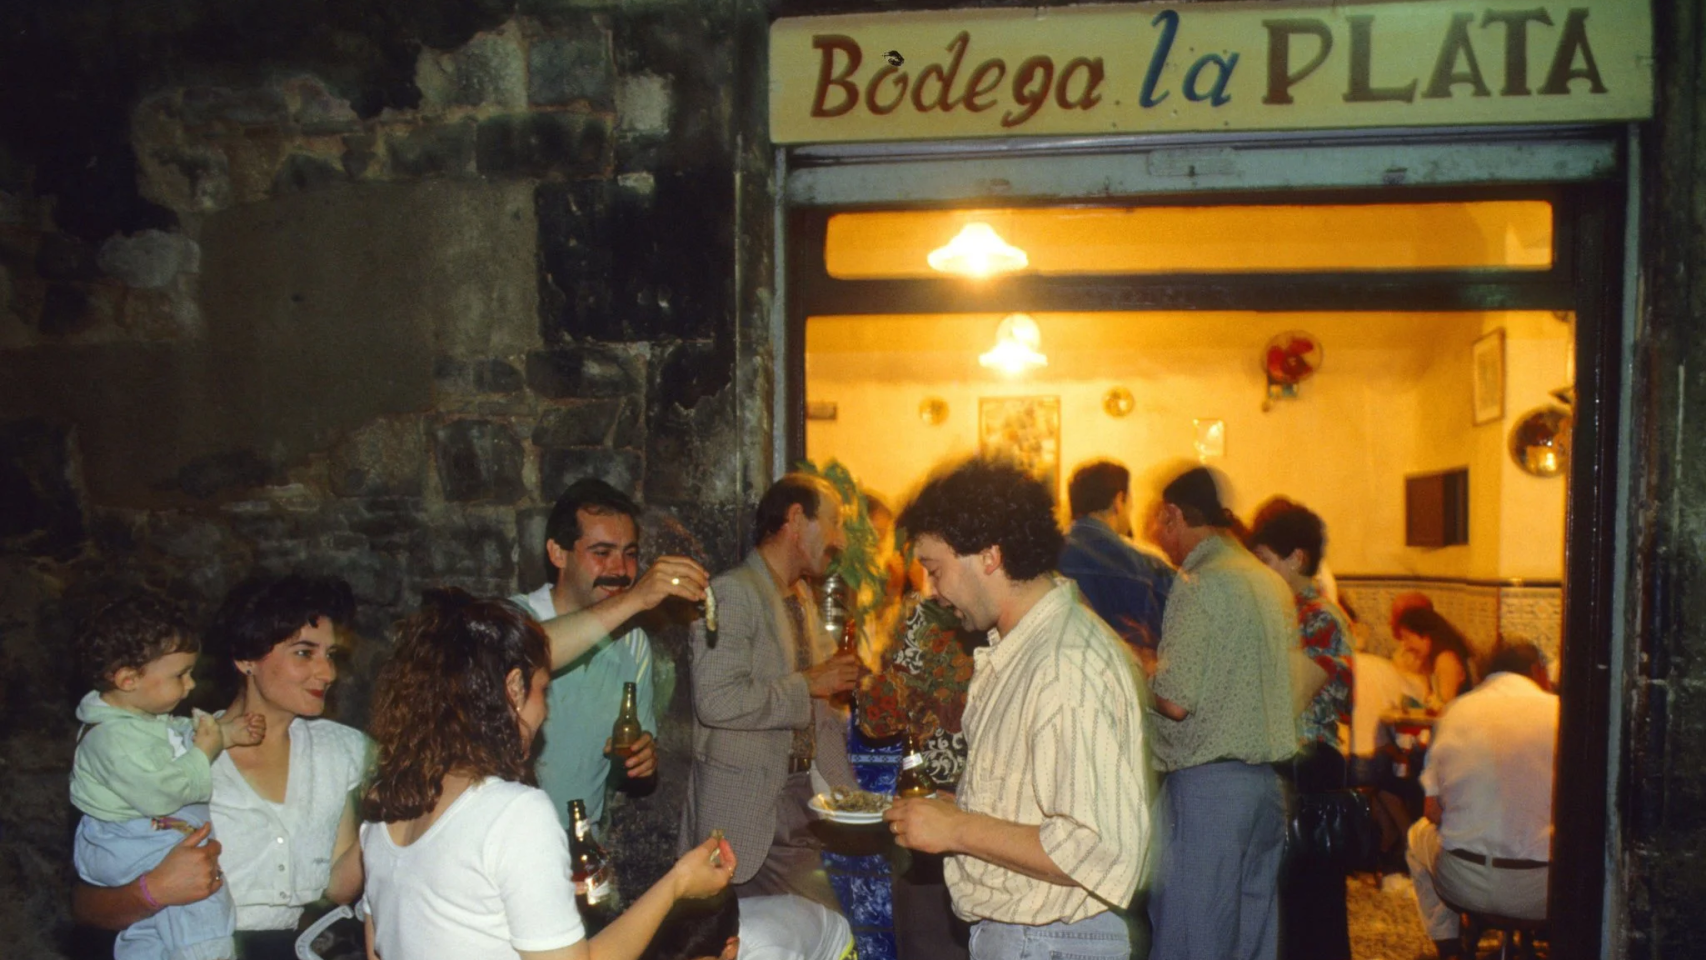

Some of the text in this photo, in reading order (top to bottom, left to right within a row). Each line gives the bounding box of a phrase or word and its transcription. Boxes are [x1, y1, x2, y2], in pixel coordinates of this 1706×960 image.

[810, 7, 1610, 128] Bodega la PLATA
